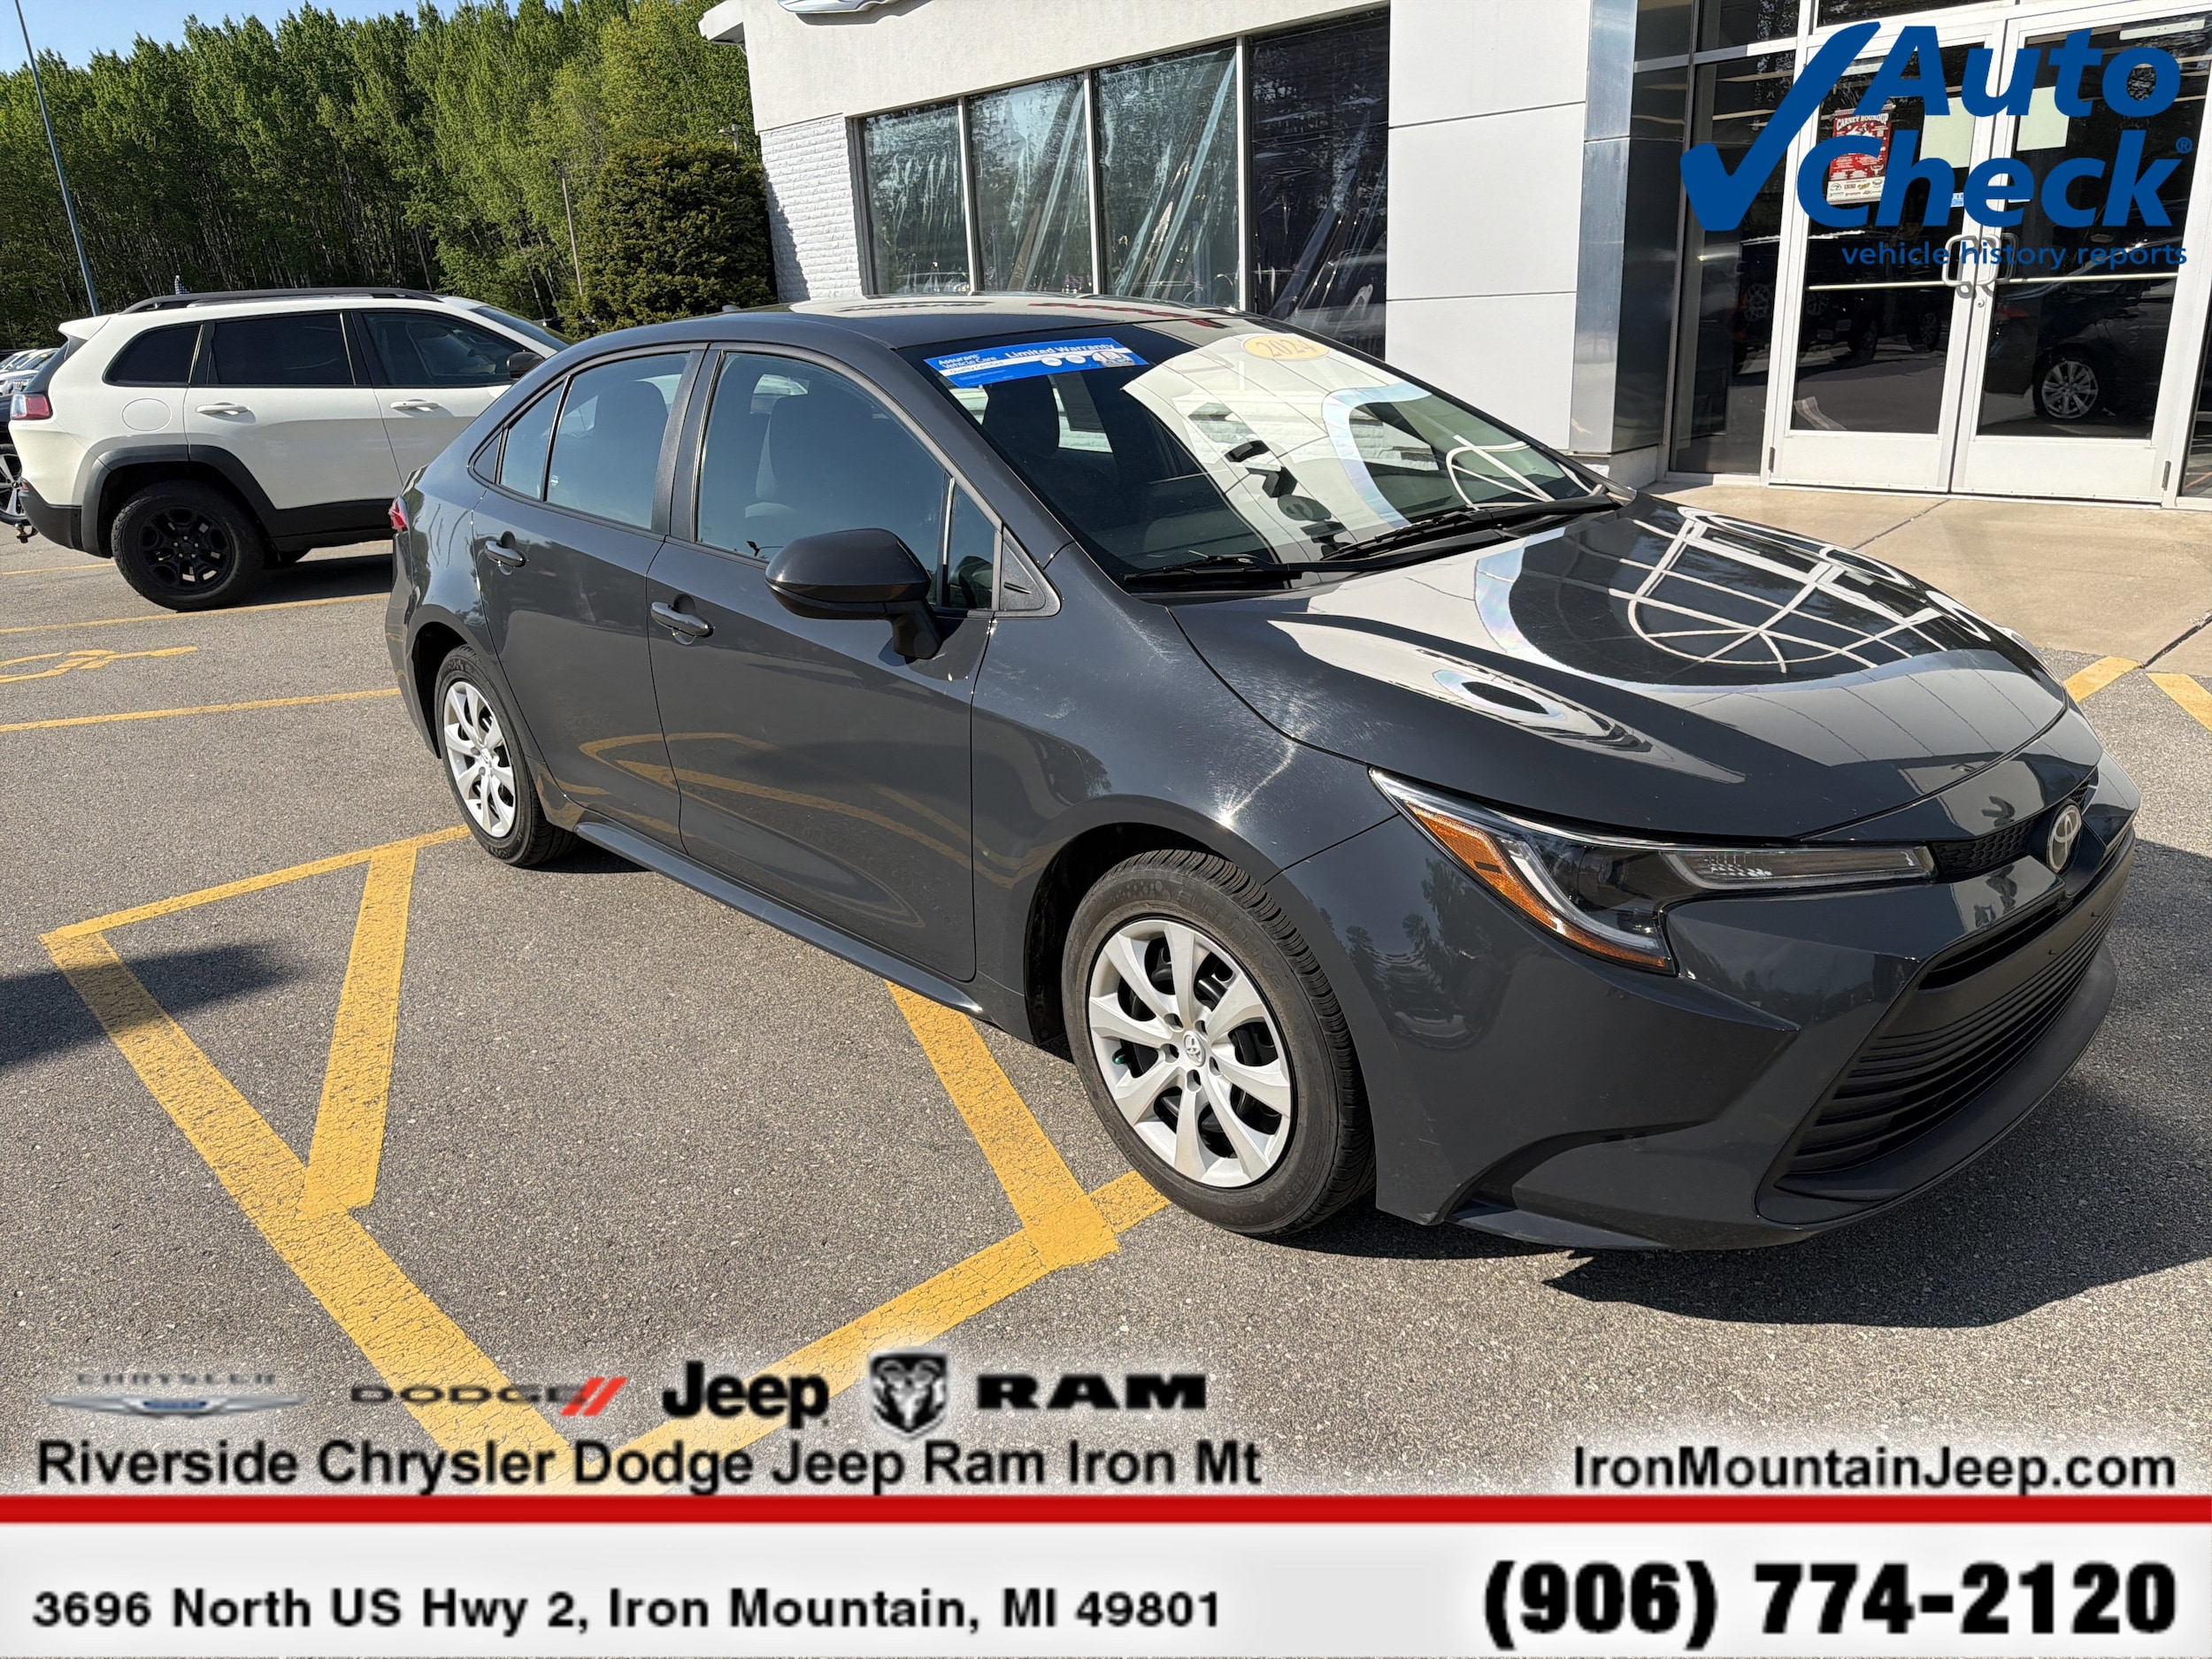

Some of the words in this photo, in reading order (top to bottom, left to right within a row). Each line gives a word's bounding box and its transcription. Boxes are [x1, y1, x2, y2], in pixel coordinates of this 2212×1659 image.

[1004, 346, 1056, 359] Limited
[1055, 343, 1116, 354] Warranty
[1256, 339, 1317, 357] 2024
[938, 354, 979, 365] Assurant
[941, 359, 976, 370] Vehicle
[976, 356, 998, 365] Care
